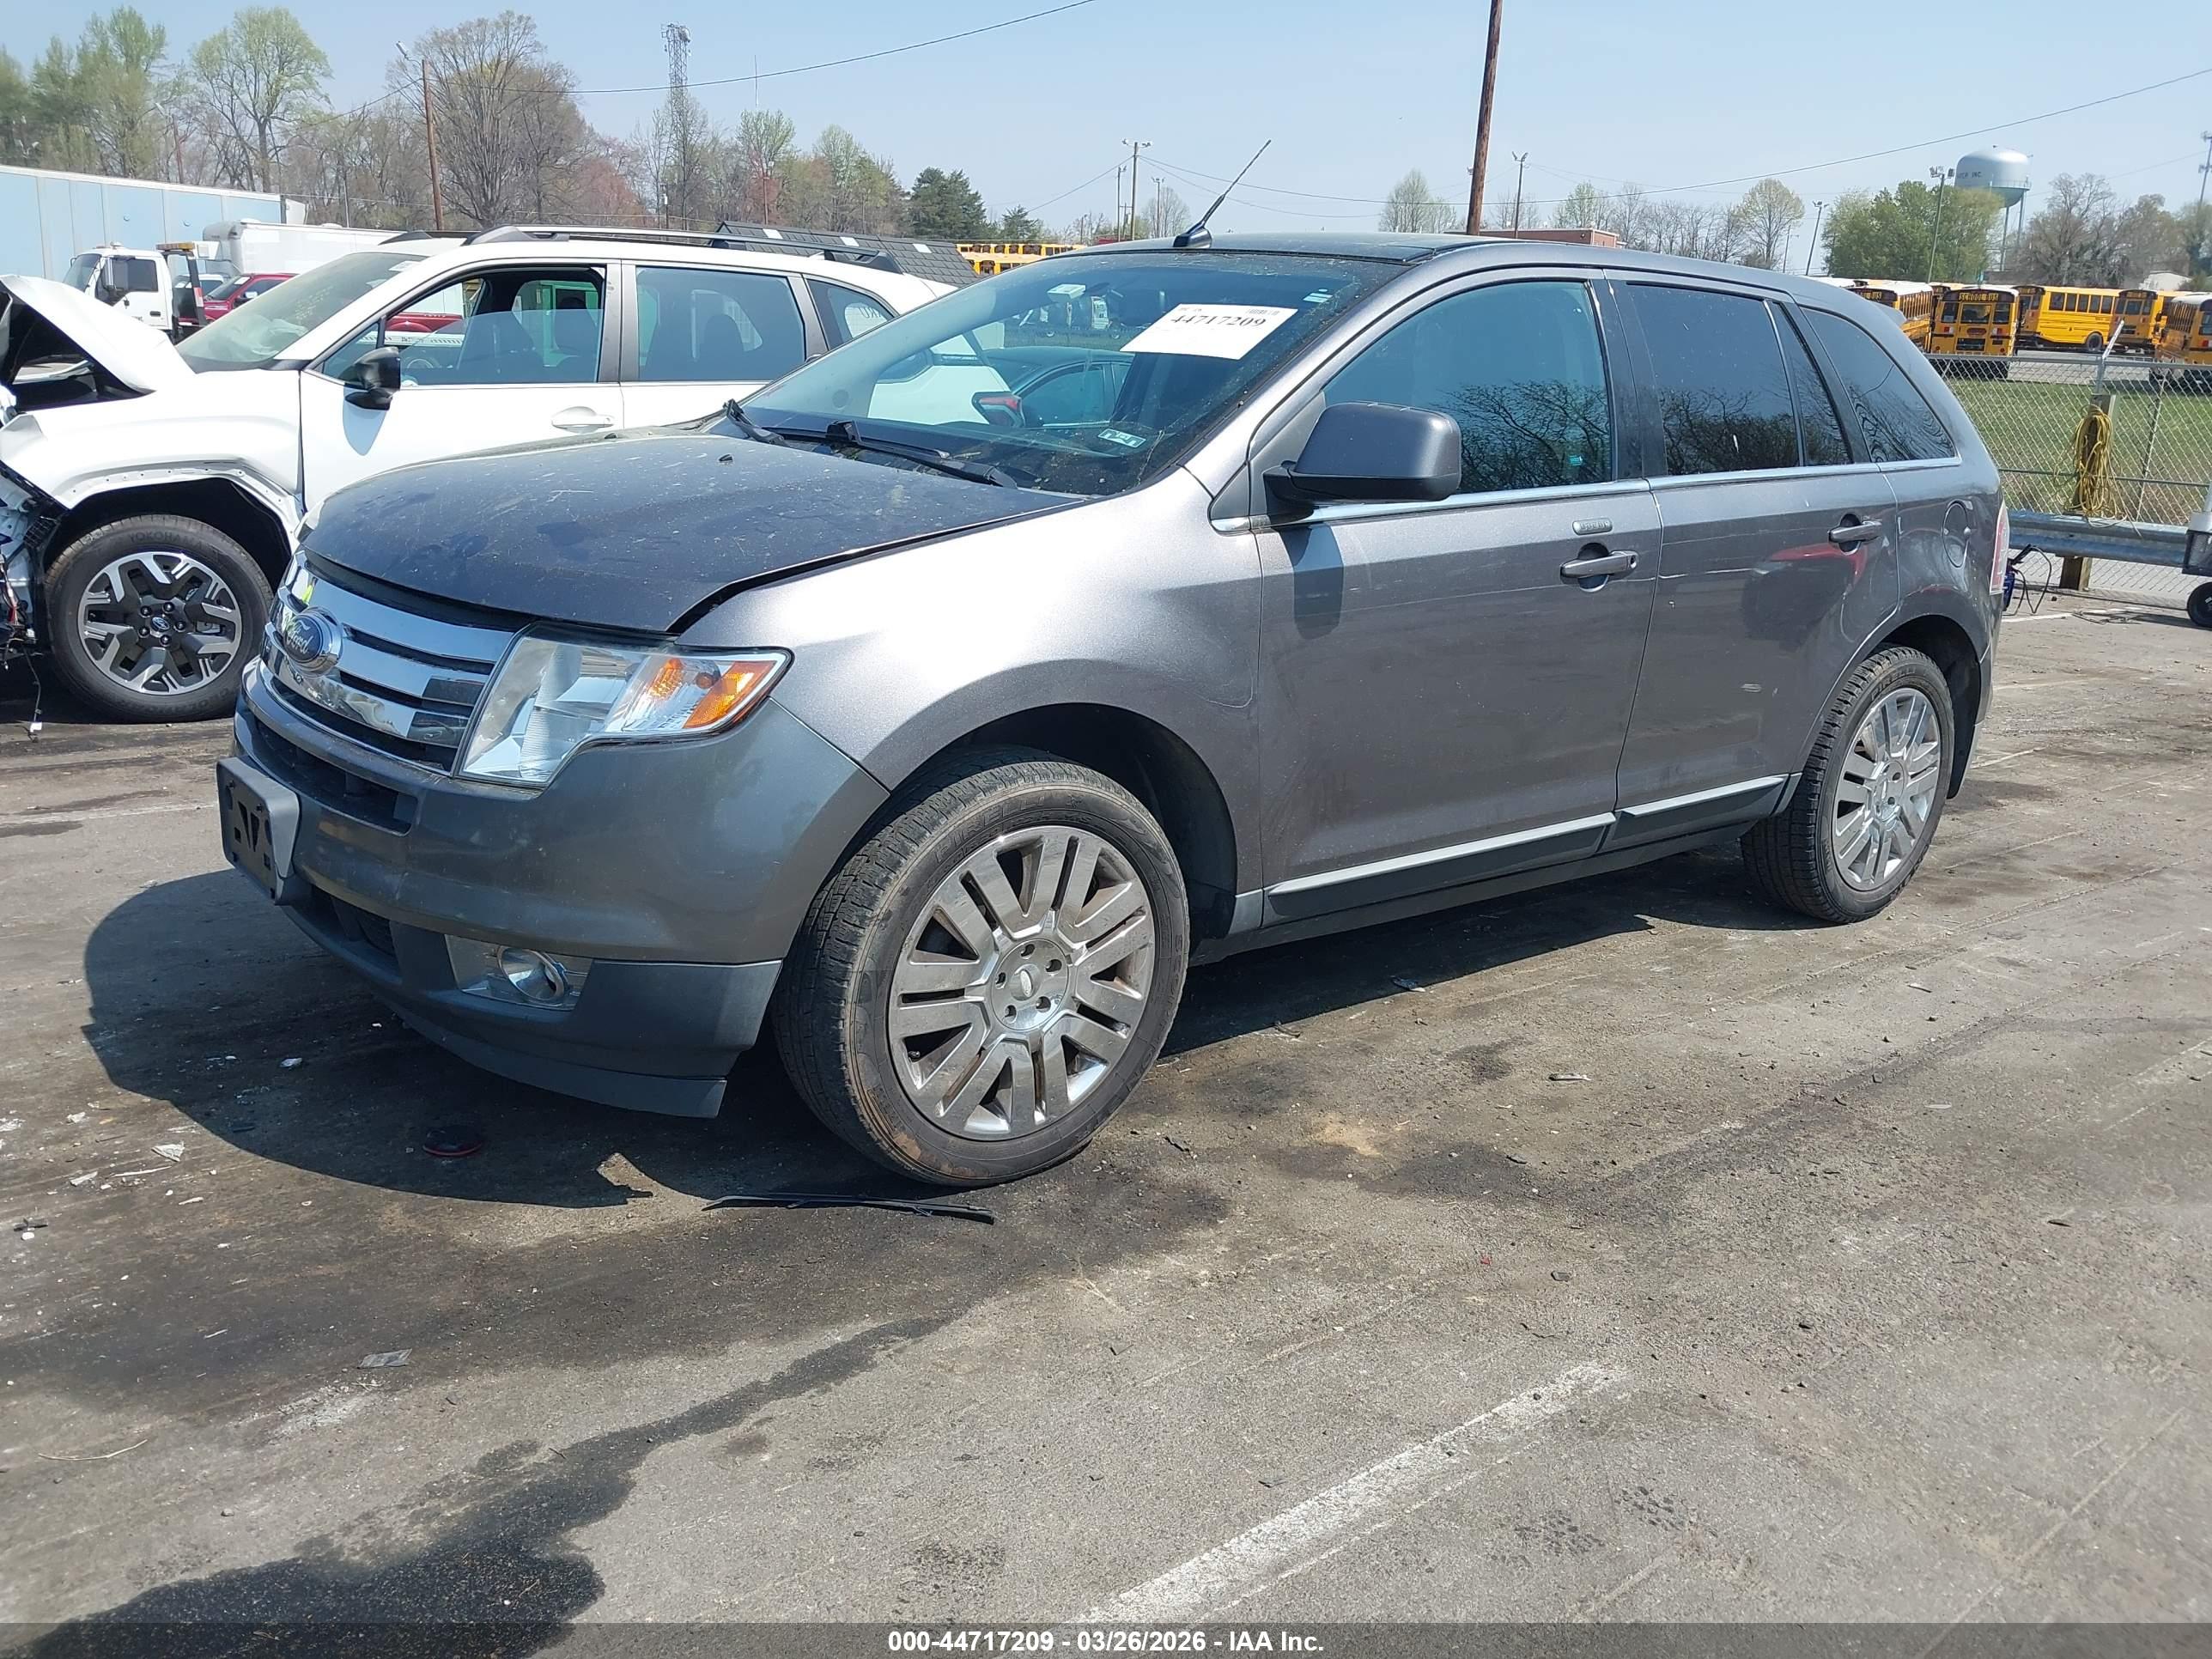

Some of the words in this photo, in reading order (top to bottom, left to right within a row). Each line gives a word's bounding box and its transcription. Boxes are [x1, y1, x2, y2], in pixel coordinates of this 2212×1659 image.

[1959, 293, 1983, 301] SCHOOL
[1170, 314, 1267, 327] 44717209
[286, 619, 314, 655] Ford
[934, 795, 1045, 864] PIRELLI
